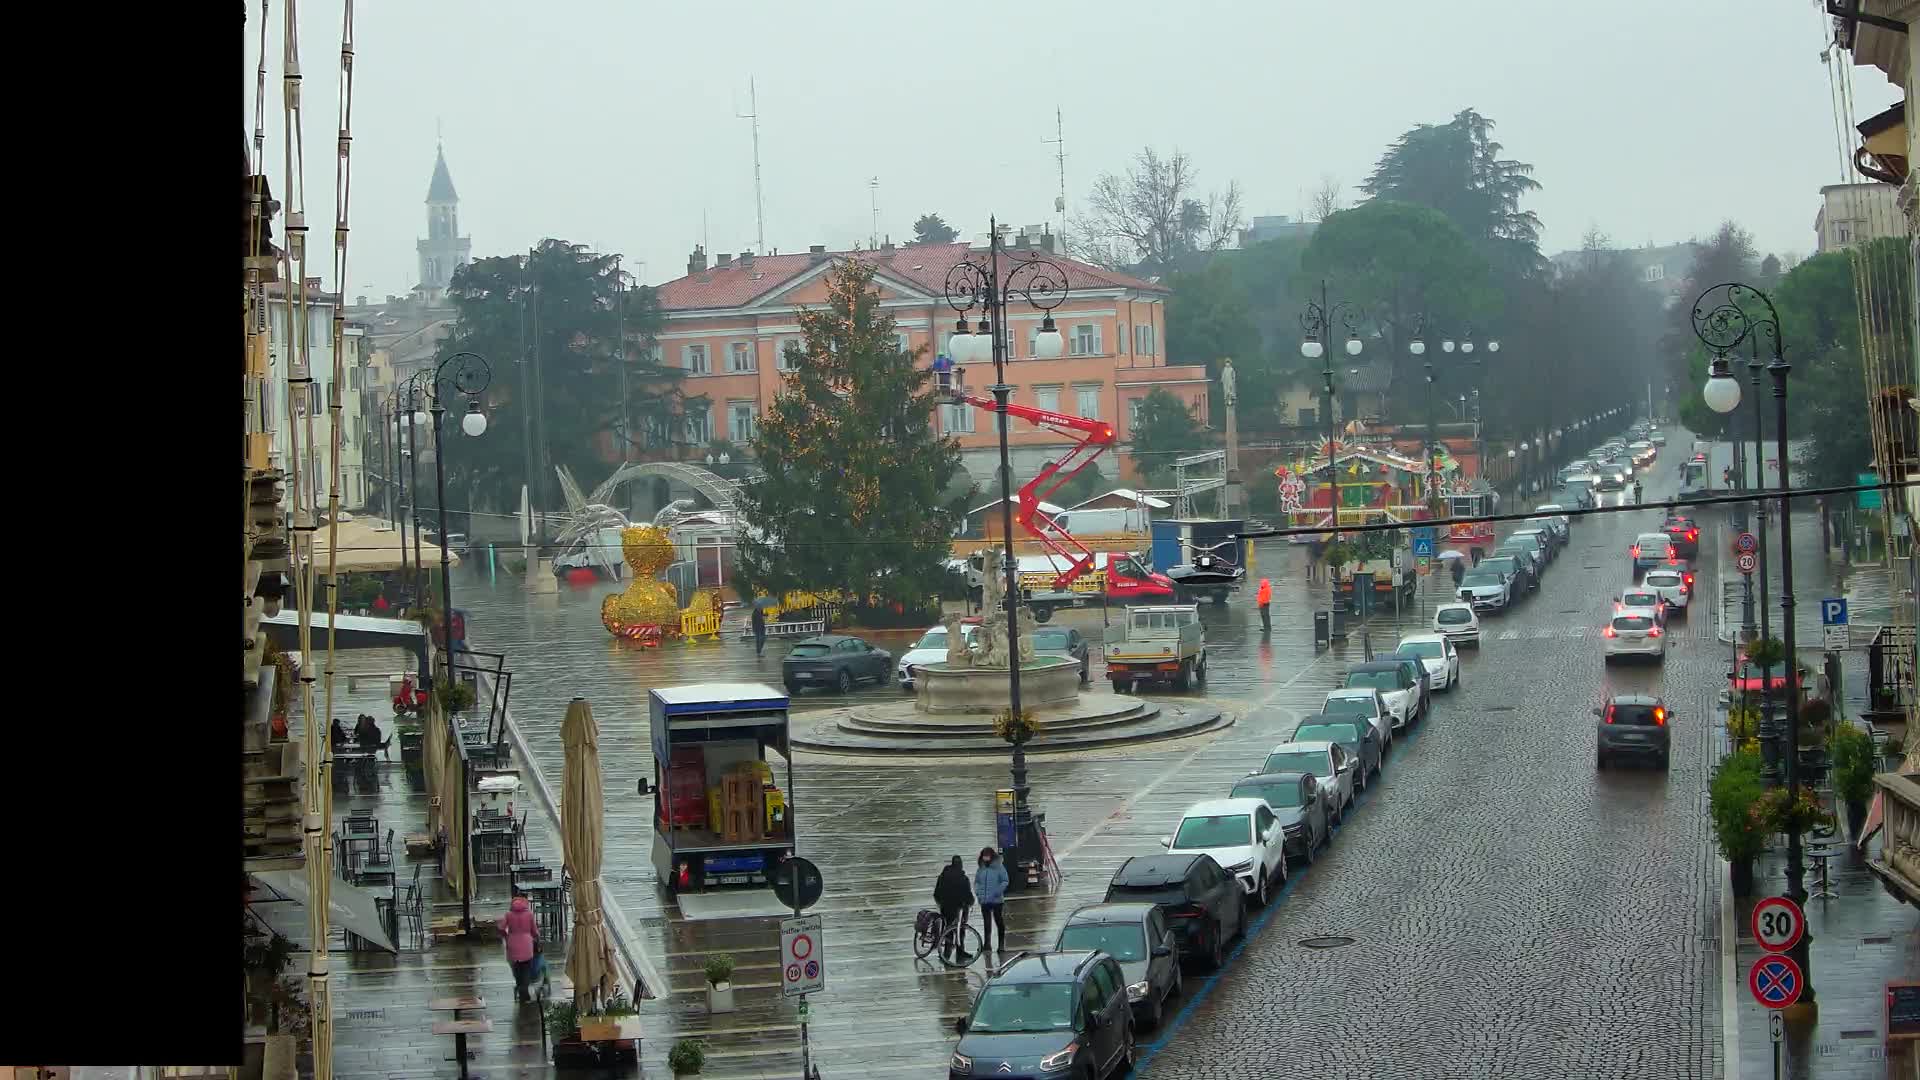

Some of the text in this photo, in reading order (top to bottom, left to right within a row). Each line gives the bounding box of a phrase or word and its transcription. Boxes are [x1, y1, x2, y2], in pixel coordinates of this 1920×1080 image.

[1742, 557, 1752, 567] 20
[1827, 602, 1842, 622] P
[1761, 911, 1792, 937] 30
[790, 969, 799, 978] 20
